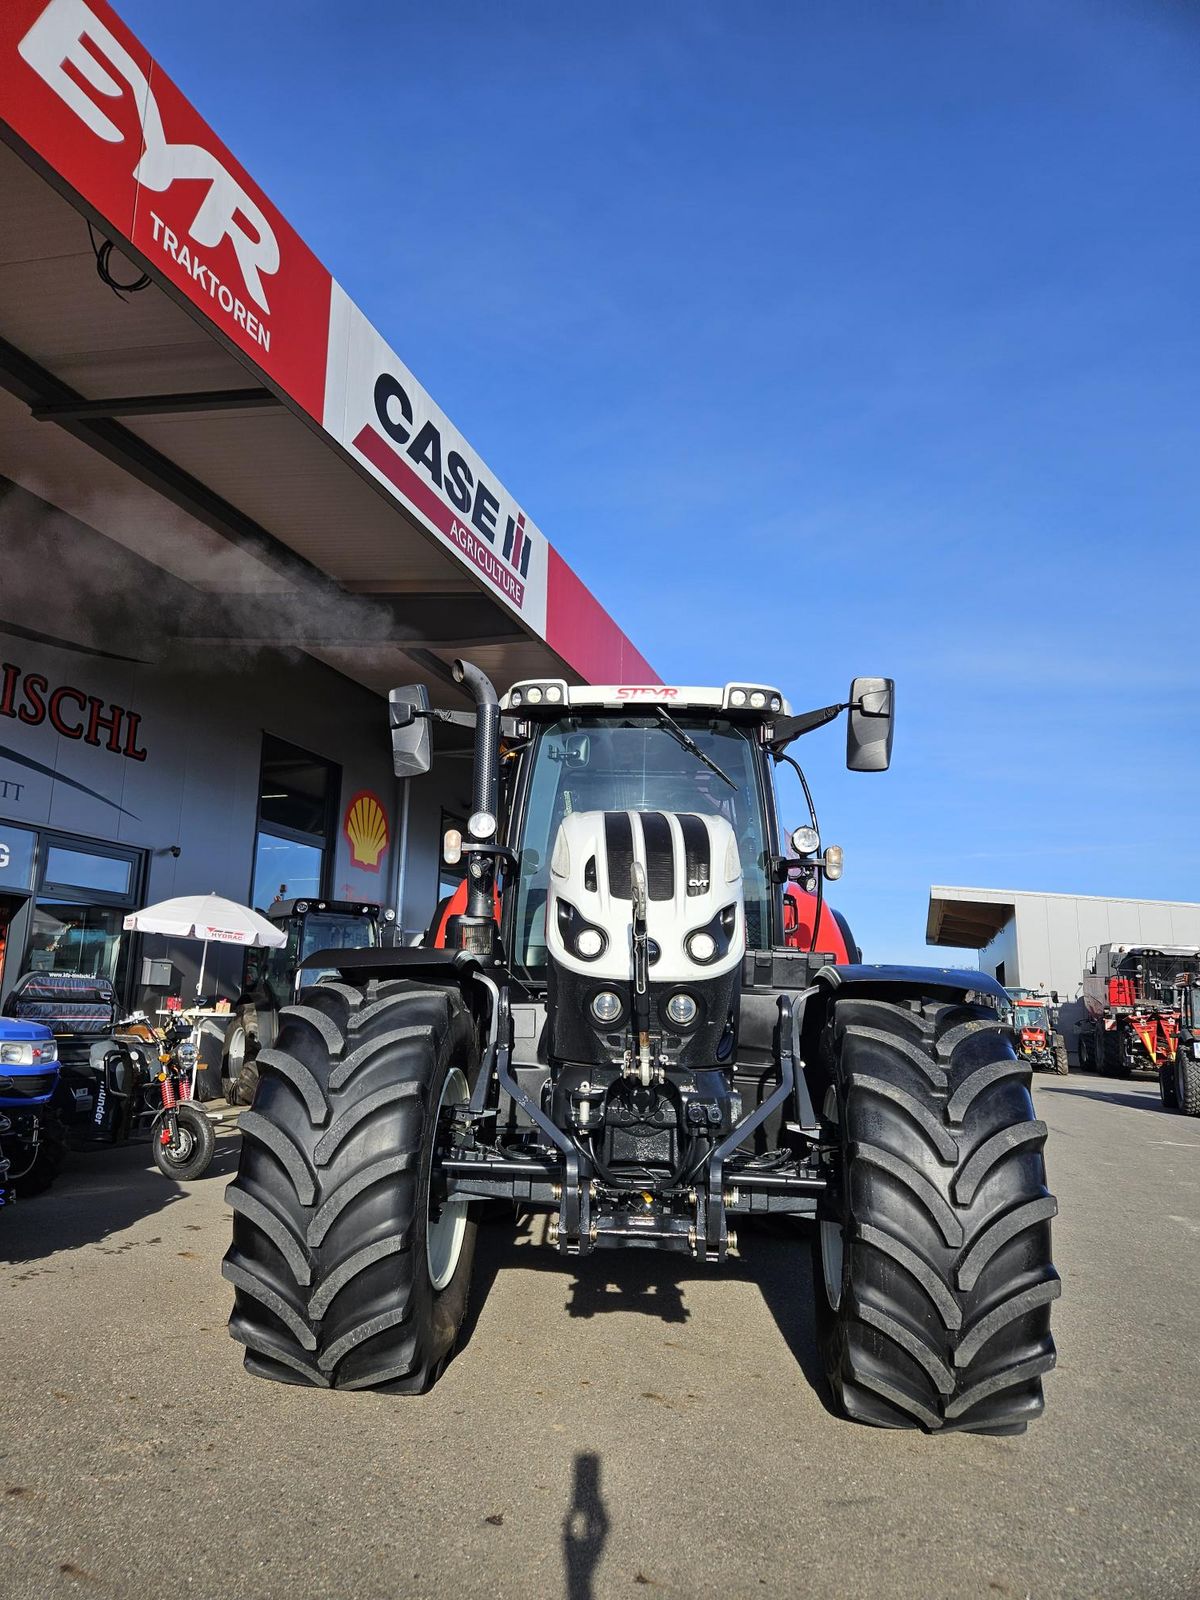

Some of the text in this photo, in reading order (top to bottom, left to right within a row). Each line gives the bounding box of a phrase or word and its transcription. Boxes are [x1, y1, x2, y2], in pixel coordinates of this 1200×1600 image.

[150, 211, 271, 353] TRAKTOREN
[374, 373, 500, 545] CASE
[450, 519, 522, 603] AGRICULTURE
[689, 880, 709, 888] CVT
